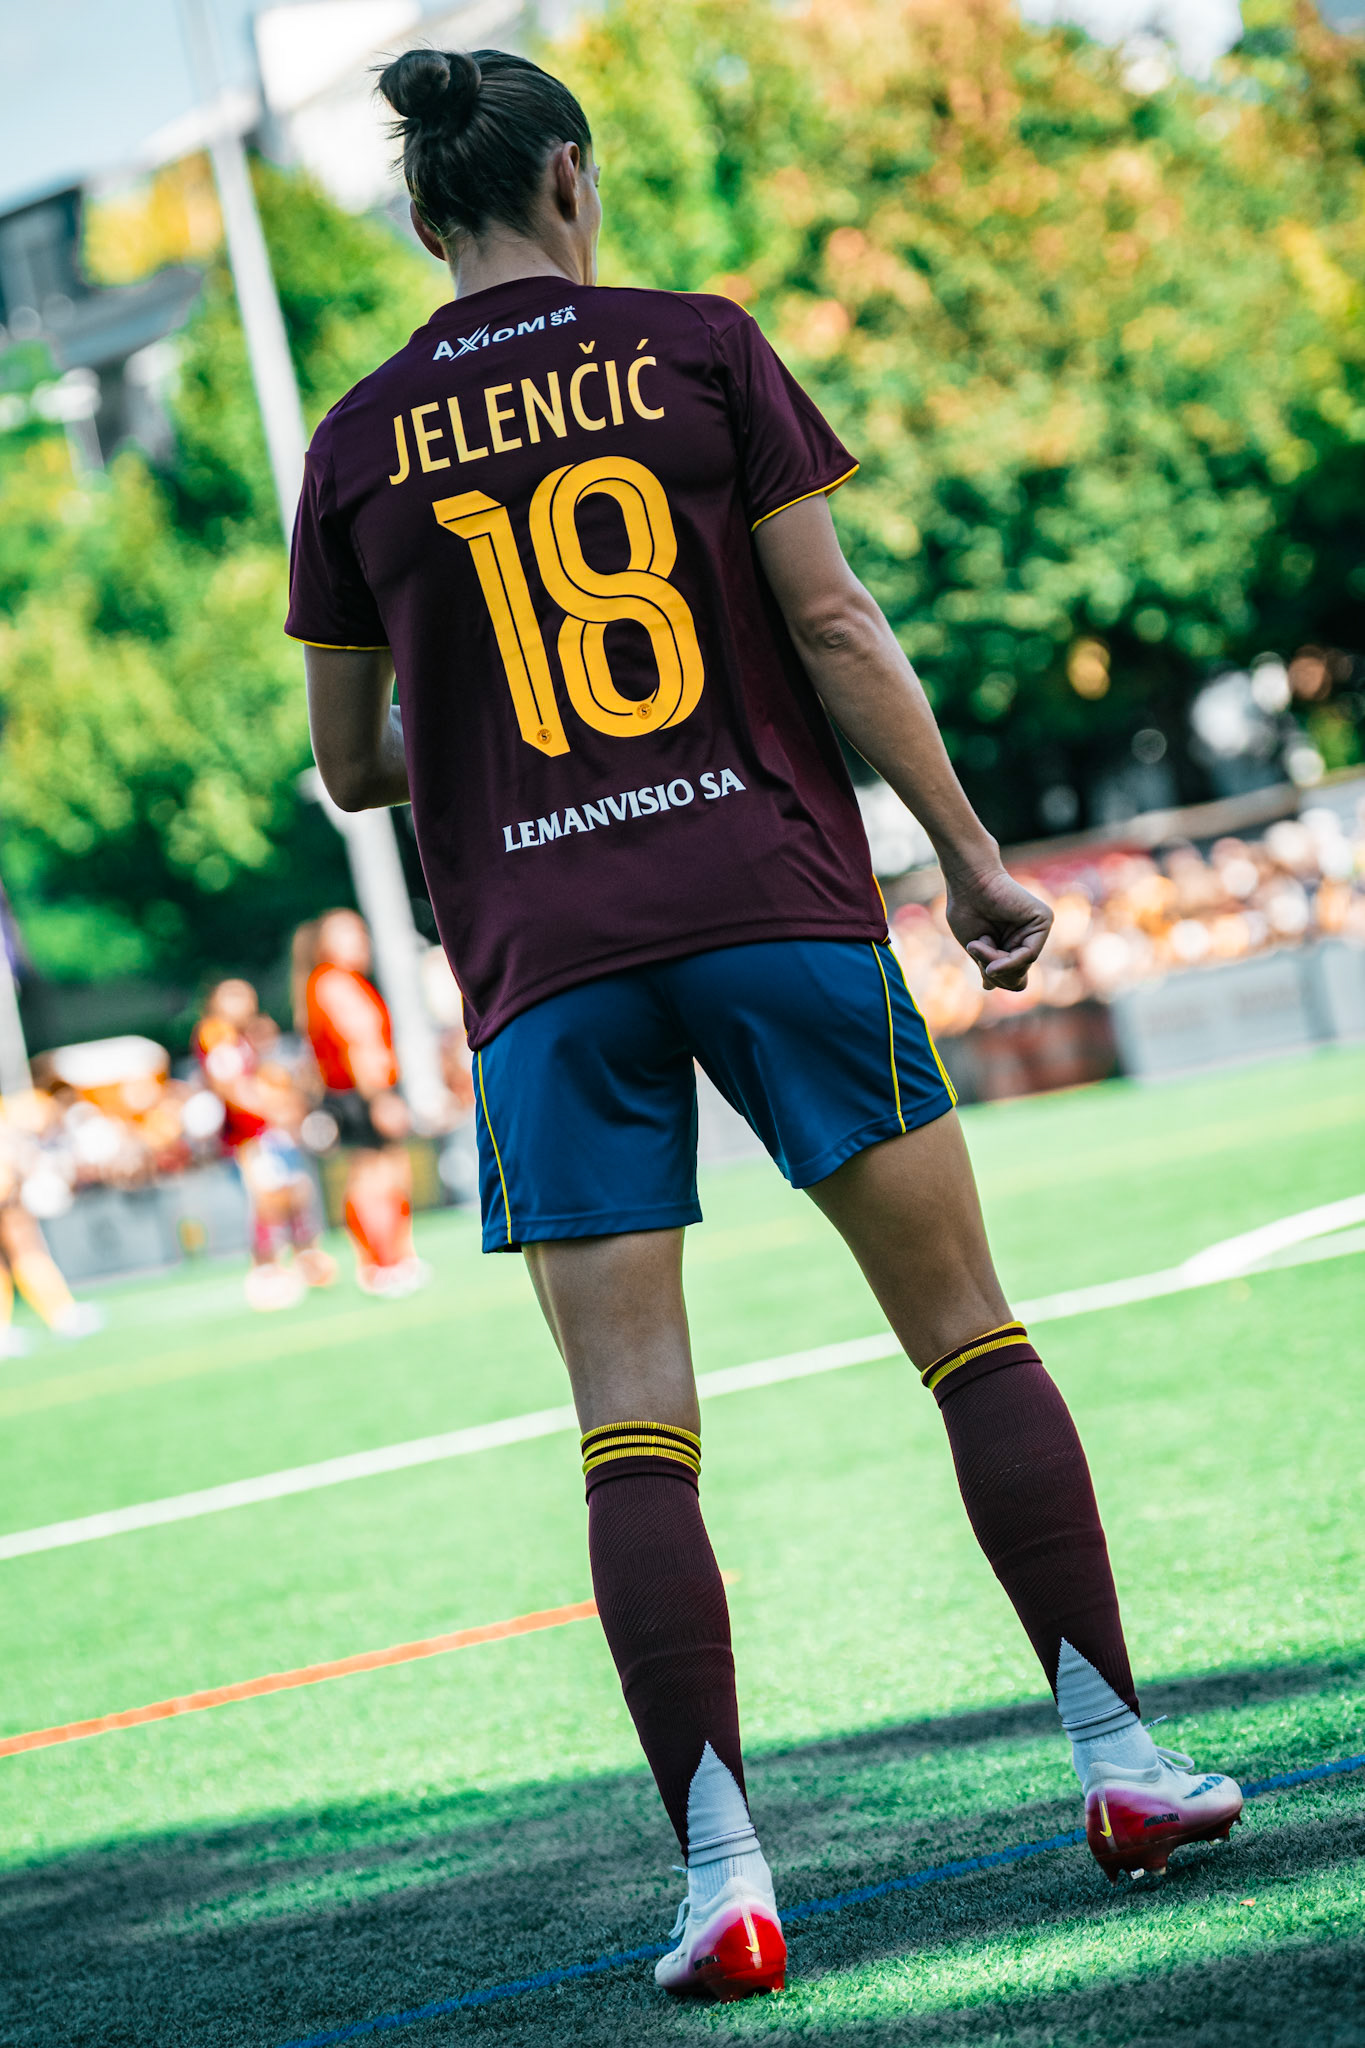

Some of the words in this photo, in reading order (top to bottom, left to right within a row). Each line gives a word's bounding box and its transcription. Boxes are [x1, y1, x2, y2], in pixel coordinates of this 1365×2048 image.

[550, 310, 577, 326] SA
[389, 338, 665, 486] JELENČIĆ
[432, 455, 705, 758] 18
[502, 778, 695, 852] LEMANVISIO
[699, 768, 746, 799] SA
